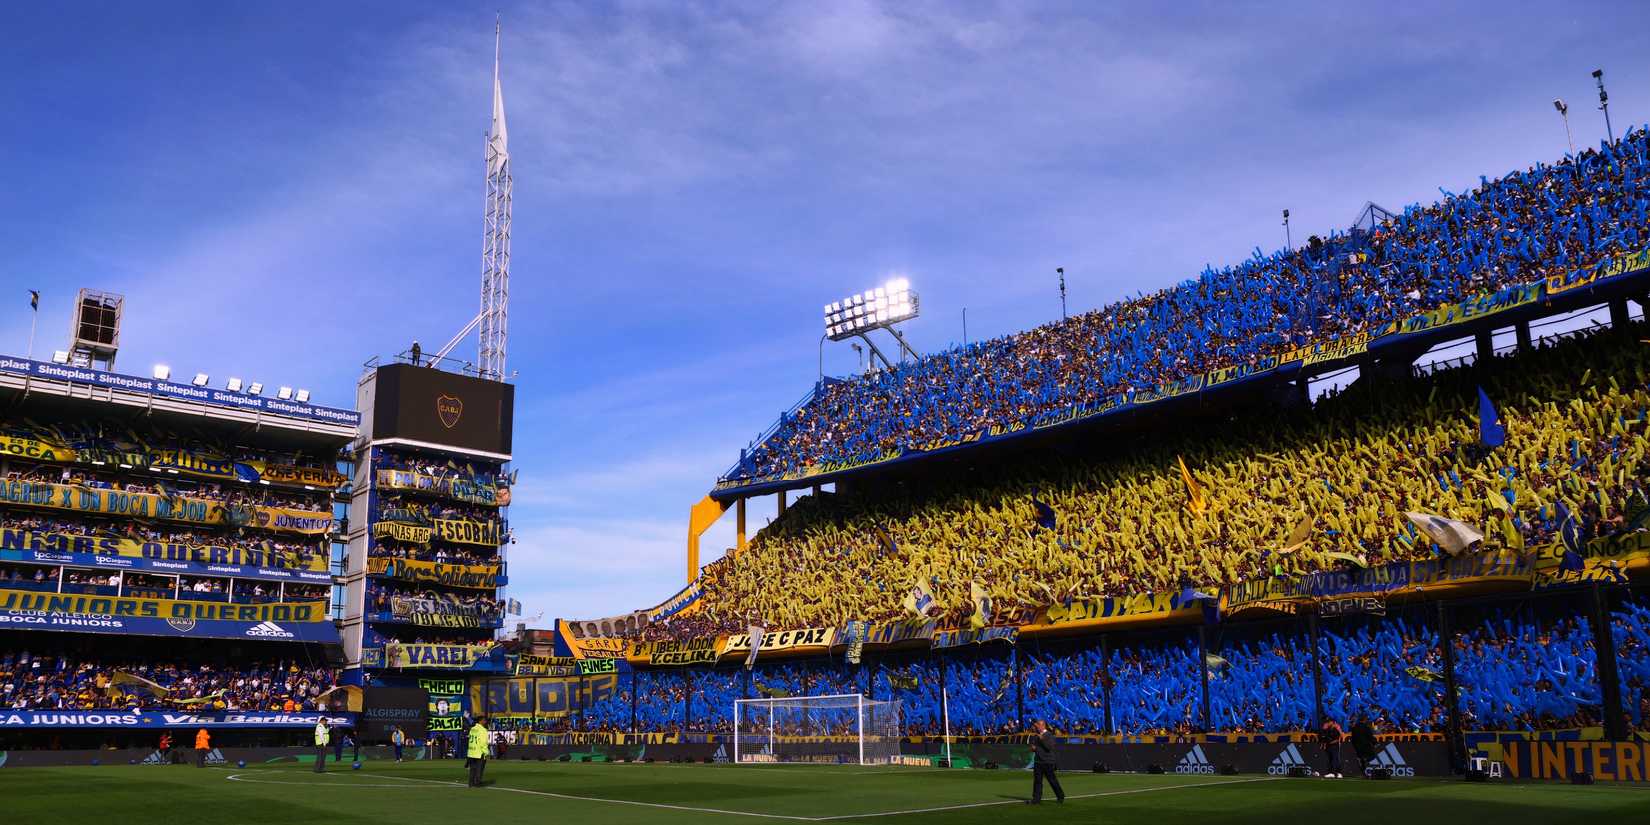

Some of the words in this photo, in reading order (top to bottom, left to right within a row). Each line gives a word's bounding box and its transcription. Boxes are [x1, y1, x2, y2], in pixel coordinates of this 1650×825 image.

[0, 360, 31, 371] plast
[38, 365, 95, 381] Sinteplast
[99, 374, 153, 390] Sinteplast
[157, 383, 208, 398] Sinteplast
[214, 392, 262, 407] Sinteplast
[267, 401, 313, 415] Sinteplast
[315, 409, 358, 422] Sinteplast
[80, 490, 101, 511] UN
[108, 491, 149, 515] BOCA
[155, 498, 208, 521] MEJOR
[153, 561, 188, 570] Sinteplast
[207, 565, 241, 573] Sinteplast
[259, 569, 291, 577] Sinteplast
[1, 593, 160, 616] JUNIORS
[171, 603, 312, 621] QUERIDO
[8, 609, 47, 617] CLUB
[0, 615, 47, 624] BOCA
[51, 618, 123, 628] JUNIORS
[246, 629, 295, 638] adidas
[779, 631, 790, 645] C
[793, 629, 826, 645] PAZ
[520, 654, 546, 666] SAN
[547, 656, 576, 667] LUIS
[580, 658, 615, 673] FUNES
[420, 680, 463, 694] CHACO
[31, 714, 138, 725] JUNIORS
[366, 708, 421, 718] ALGISPRAY
[427, 718, 461, 730] SALTA
[891, 755, 901, 764] LA
[903, 757, 931, 766] NUEVA
[1175, 762, 1217, 774] adidas
